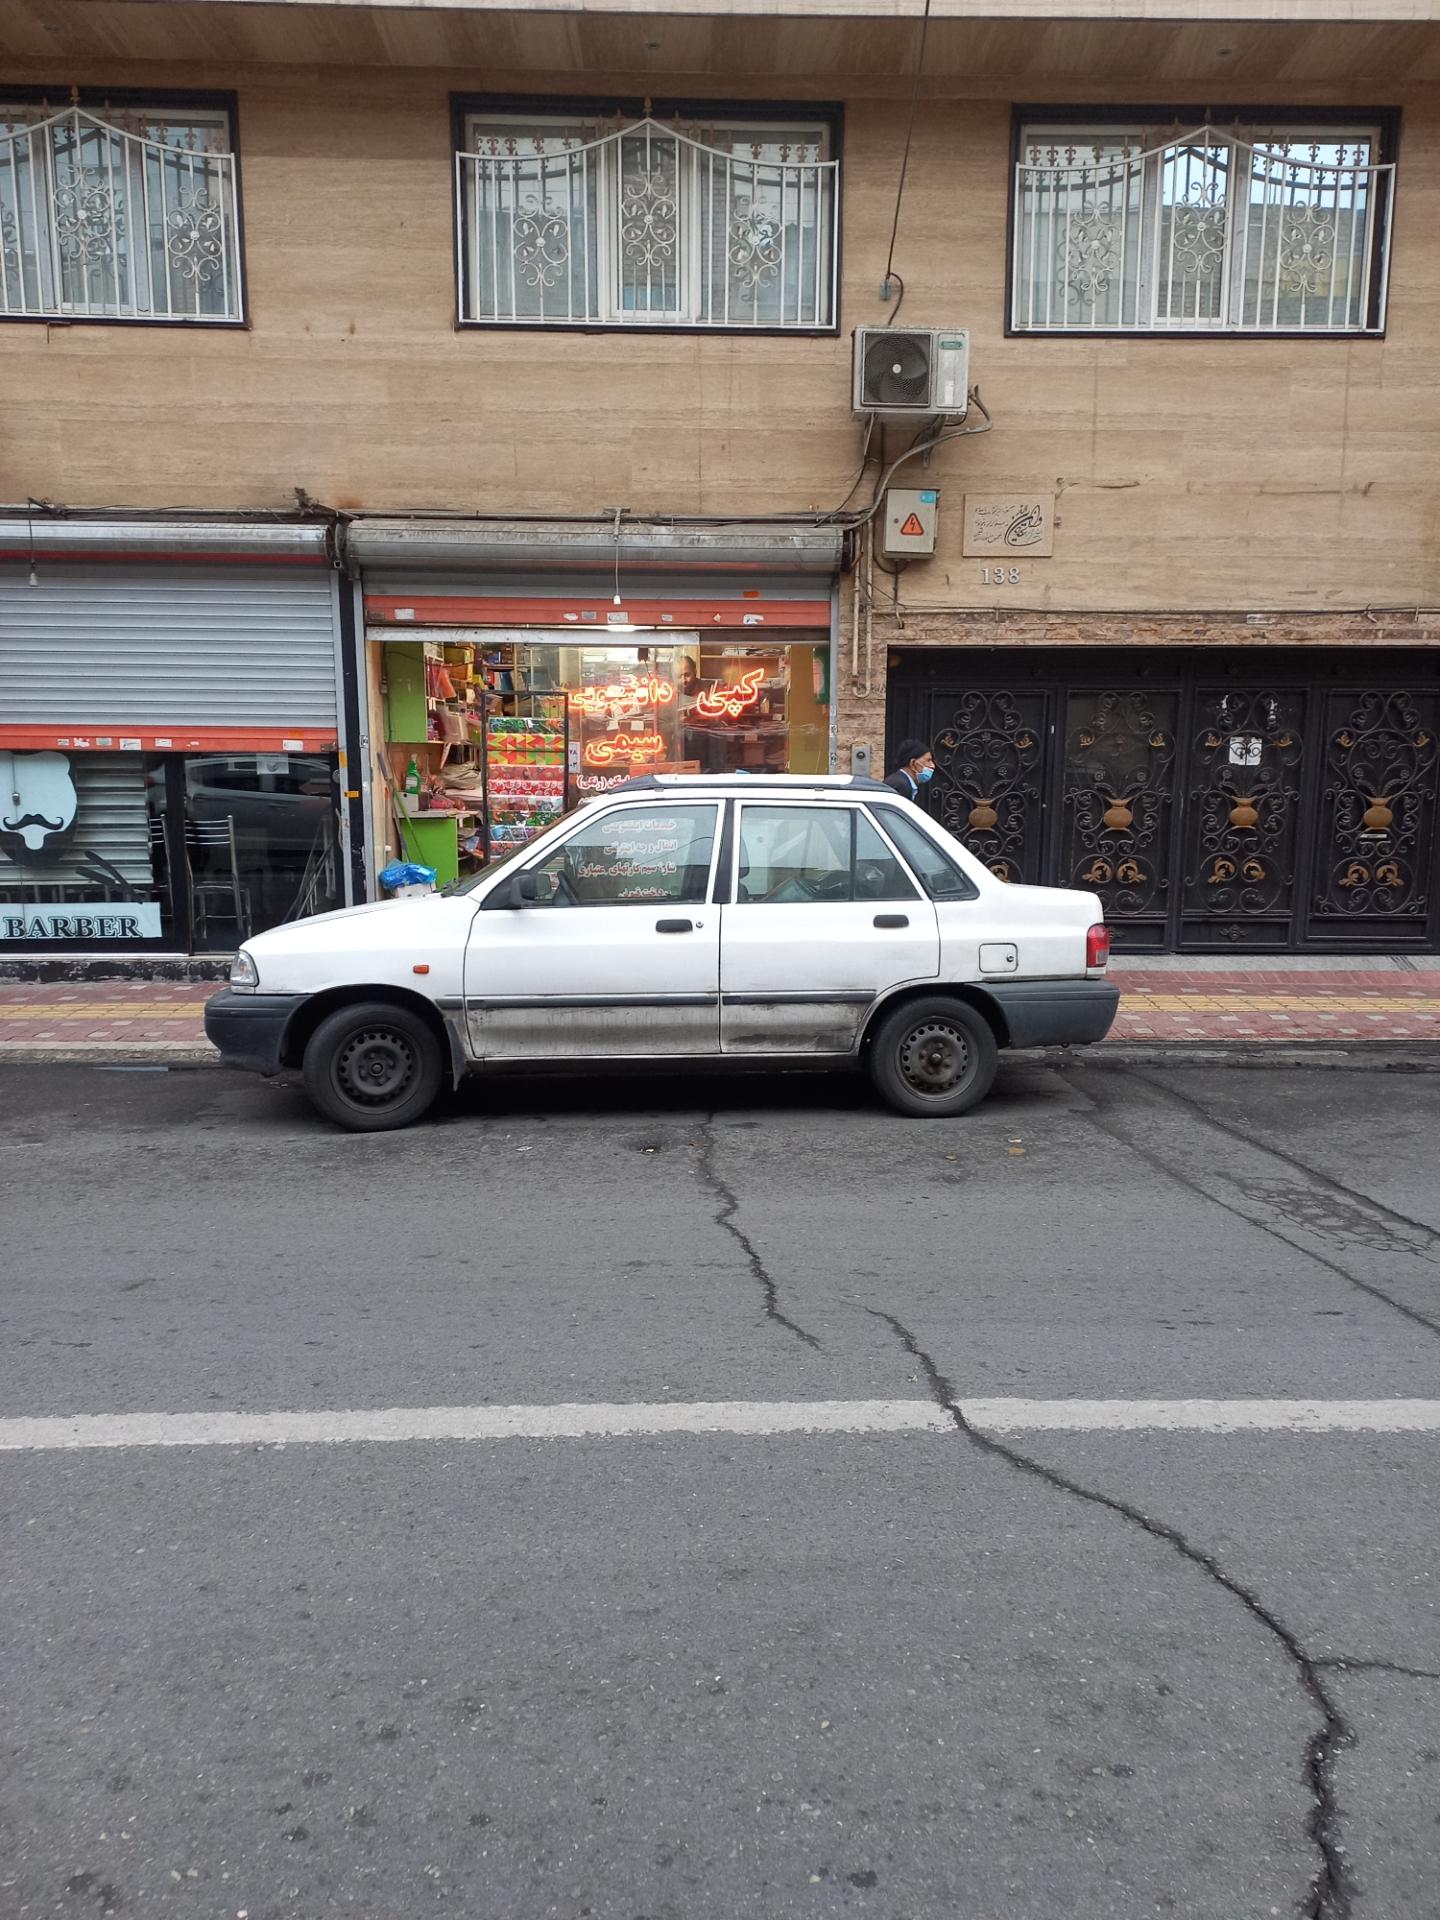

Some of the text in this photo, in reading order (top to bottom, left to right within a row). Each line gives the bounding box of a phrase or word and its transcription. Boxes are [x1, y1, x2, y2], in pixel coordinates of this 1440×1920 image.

[981, 567, 1020, 585] 138
[568, 668, 764, 716] کپی دانشجویی
[586, 734, 663, 764] سیمی
[3, 916, 143, 938] BARBER
